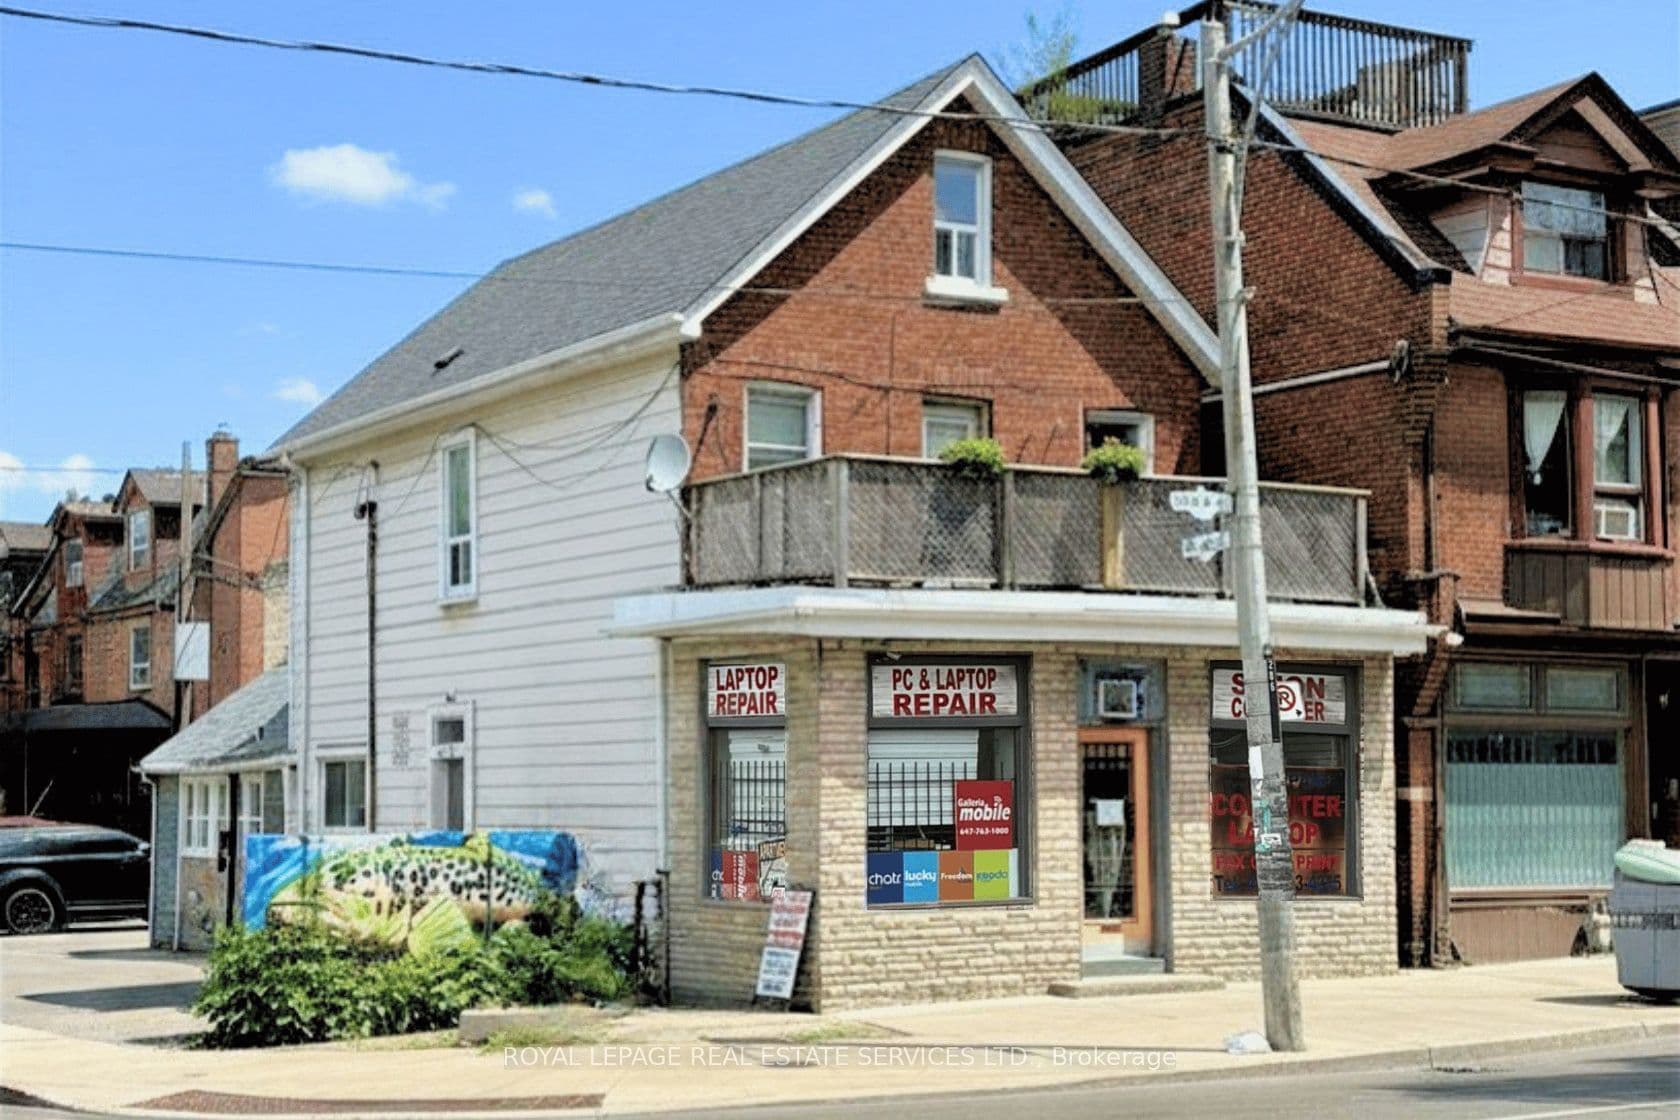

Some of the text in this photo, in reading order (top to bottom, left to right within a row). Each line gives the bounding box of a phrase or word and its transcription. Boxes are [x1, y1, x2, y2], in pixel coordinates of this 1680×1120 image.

[716, 665, 778, 691] LAPTOP
[892, 668, 997, 691] PC & LAPTOP
[716, 692, 778, 715] REPAIR
[893, 693, 998, 715] REPAIR
[959, 803, 1011, 821] mobile
[1227, 820, 1319, 845] LAOP
[904, 869, 938, 883] lucky
